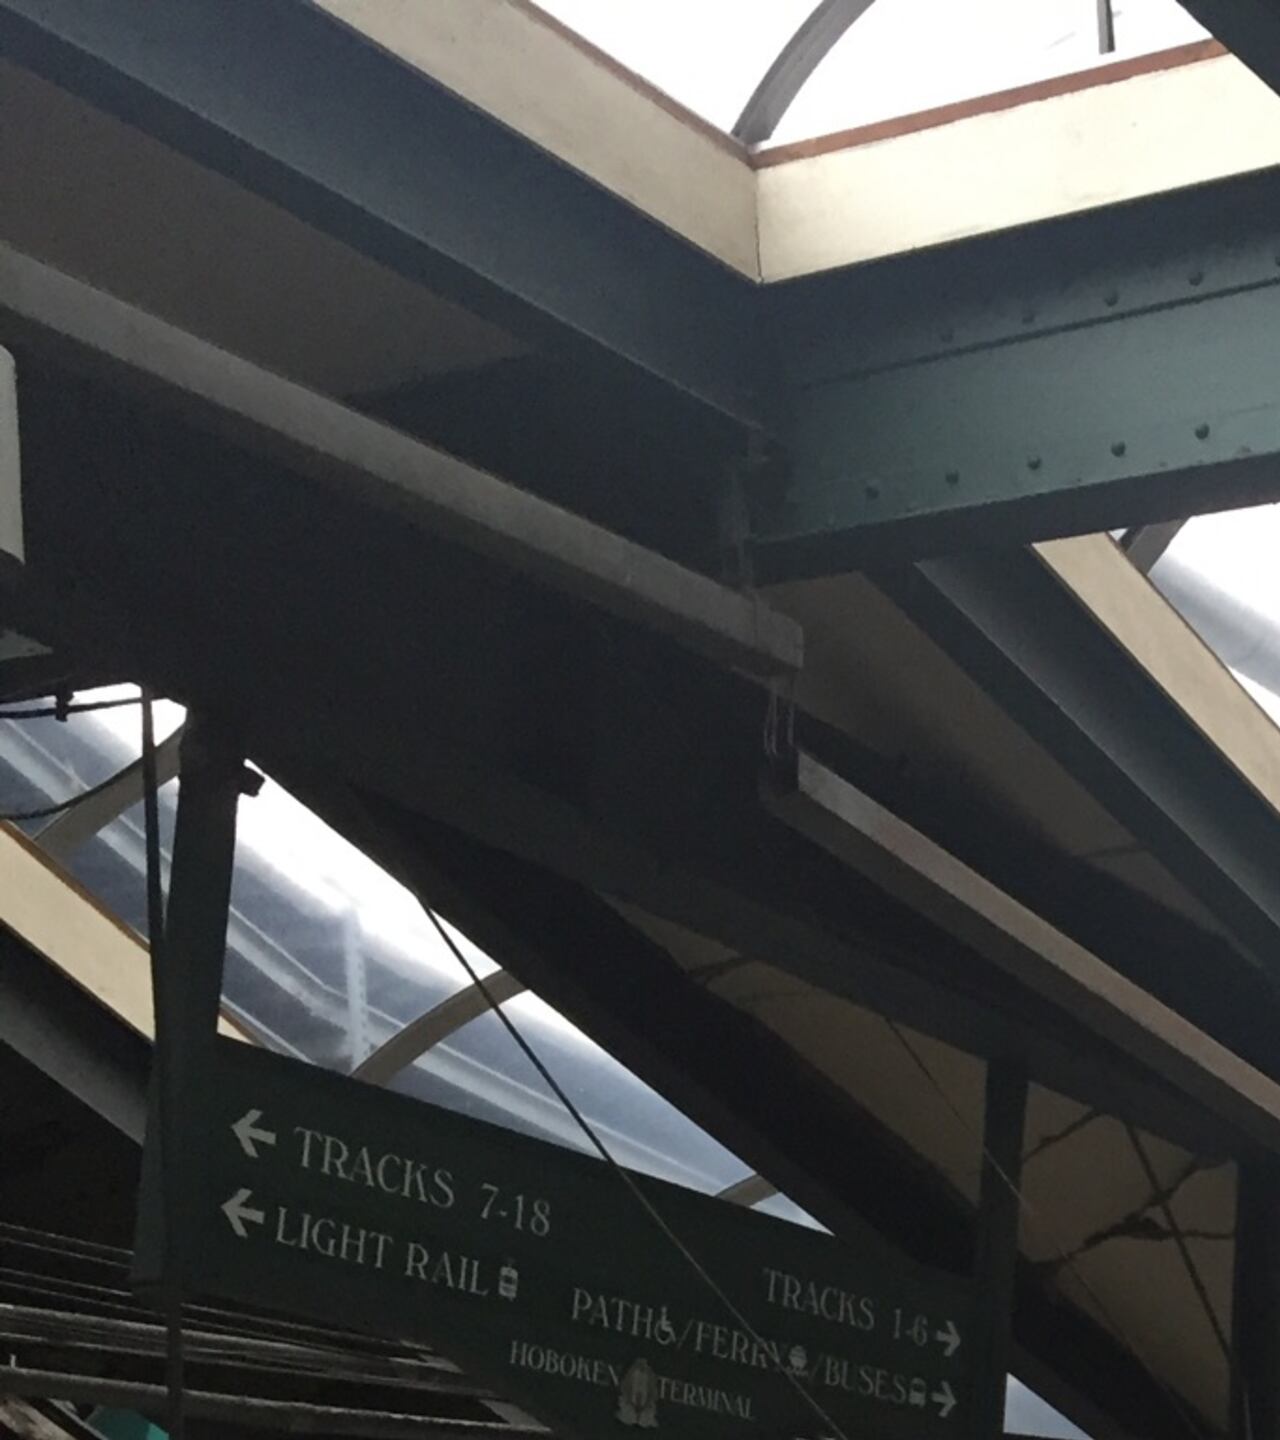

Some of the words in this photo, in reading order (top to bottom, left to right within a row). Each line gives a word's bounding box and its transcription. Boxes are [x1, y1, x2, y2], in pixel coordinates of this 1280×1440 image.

[293, 1126, 456, 1208] TRACKS
[480, 1181, 552, 1237] 7-18
[274, 1205, 394, 1270] LIGHT
[404, 1241, 489, 1297] RAIL
[571, 1287, 654, 1340] PATH
[762, 1266, 876, 1332] TRACKS
[892, 1307, 929, 1348] 1-6
[509, 1340, 622, 1387] HOBOKEN
[655, 1374, 756, 1422] TERMINAL
